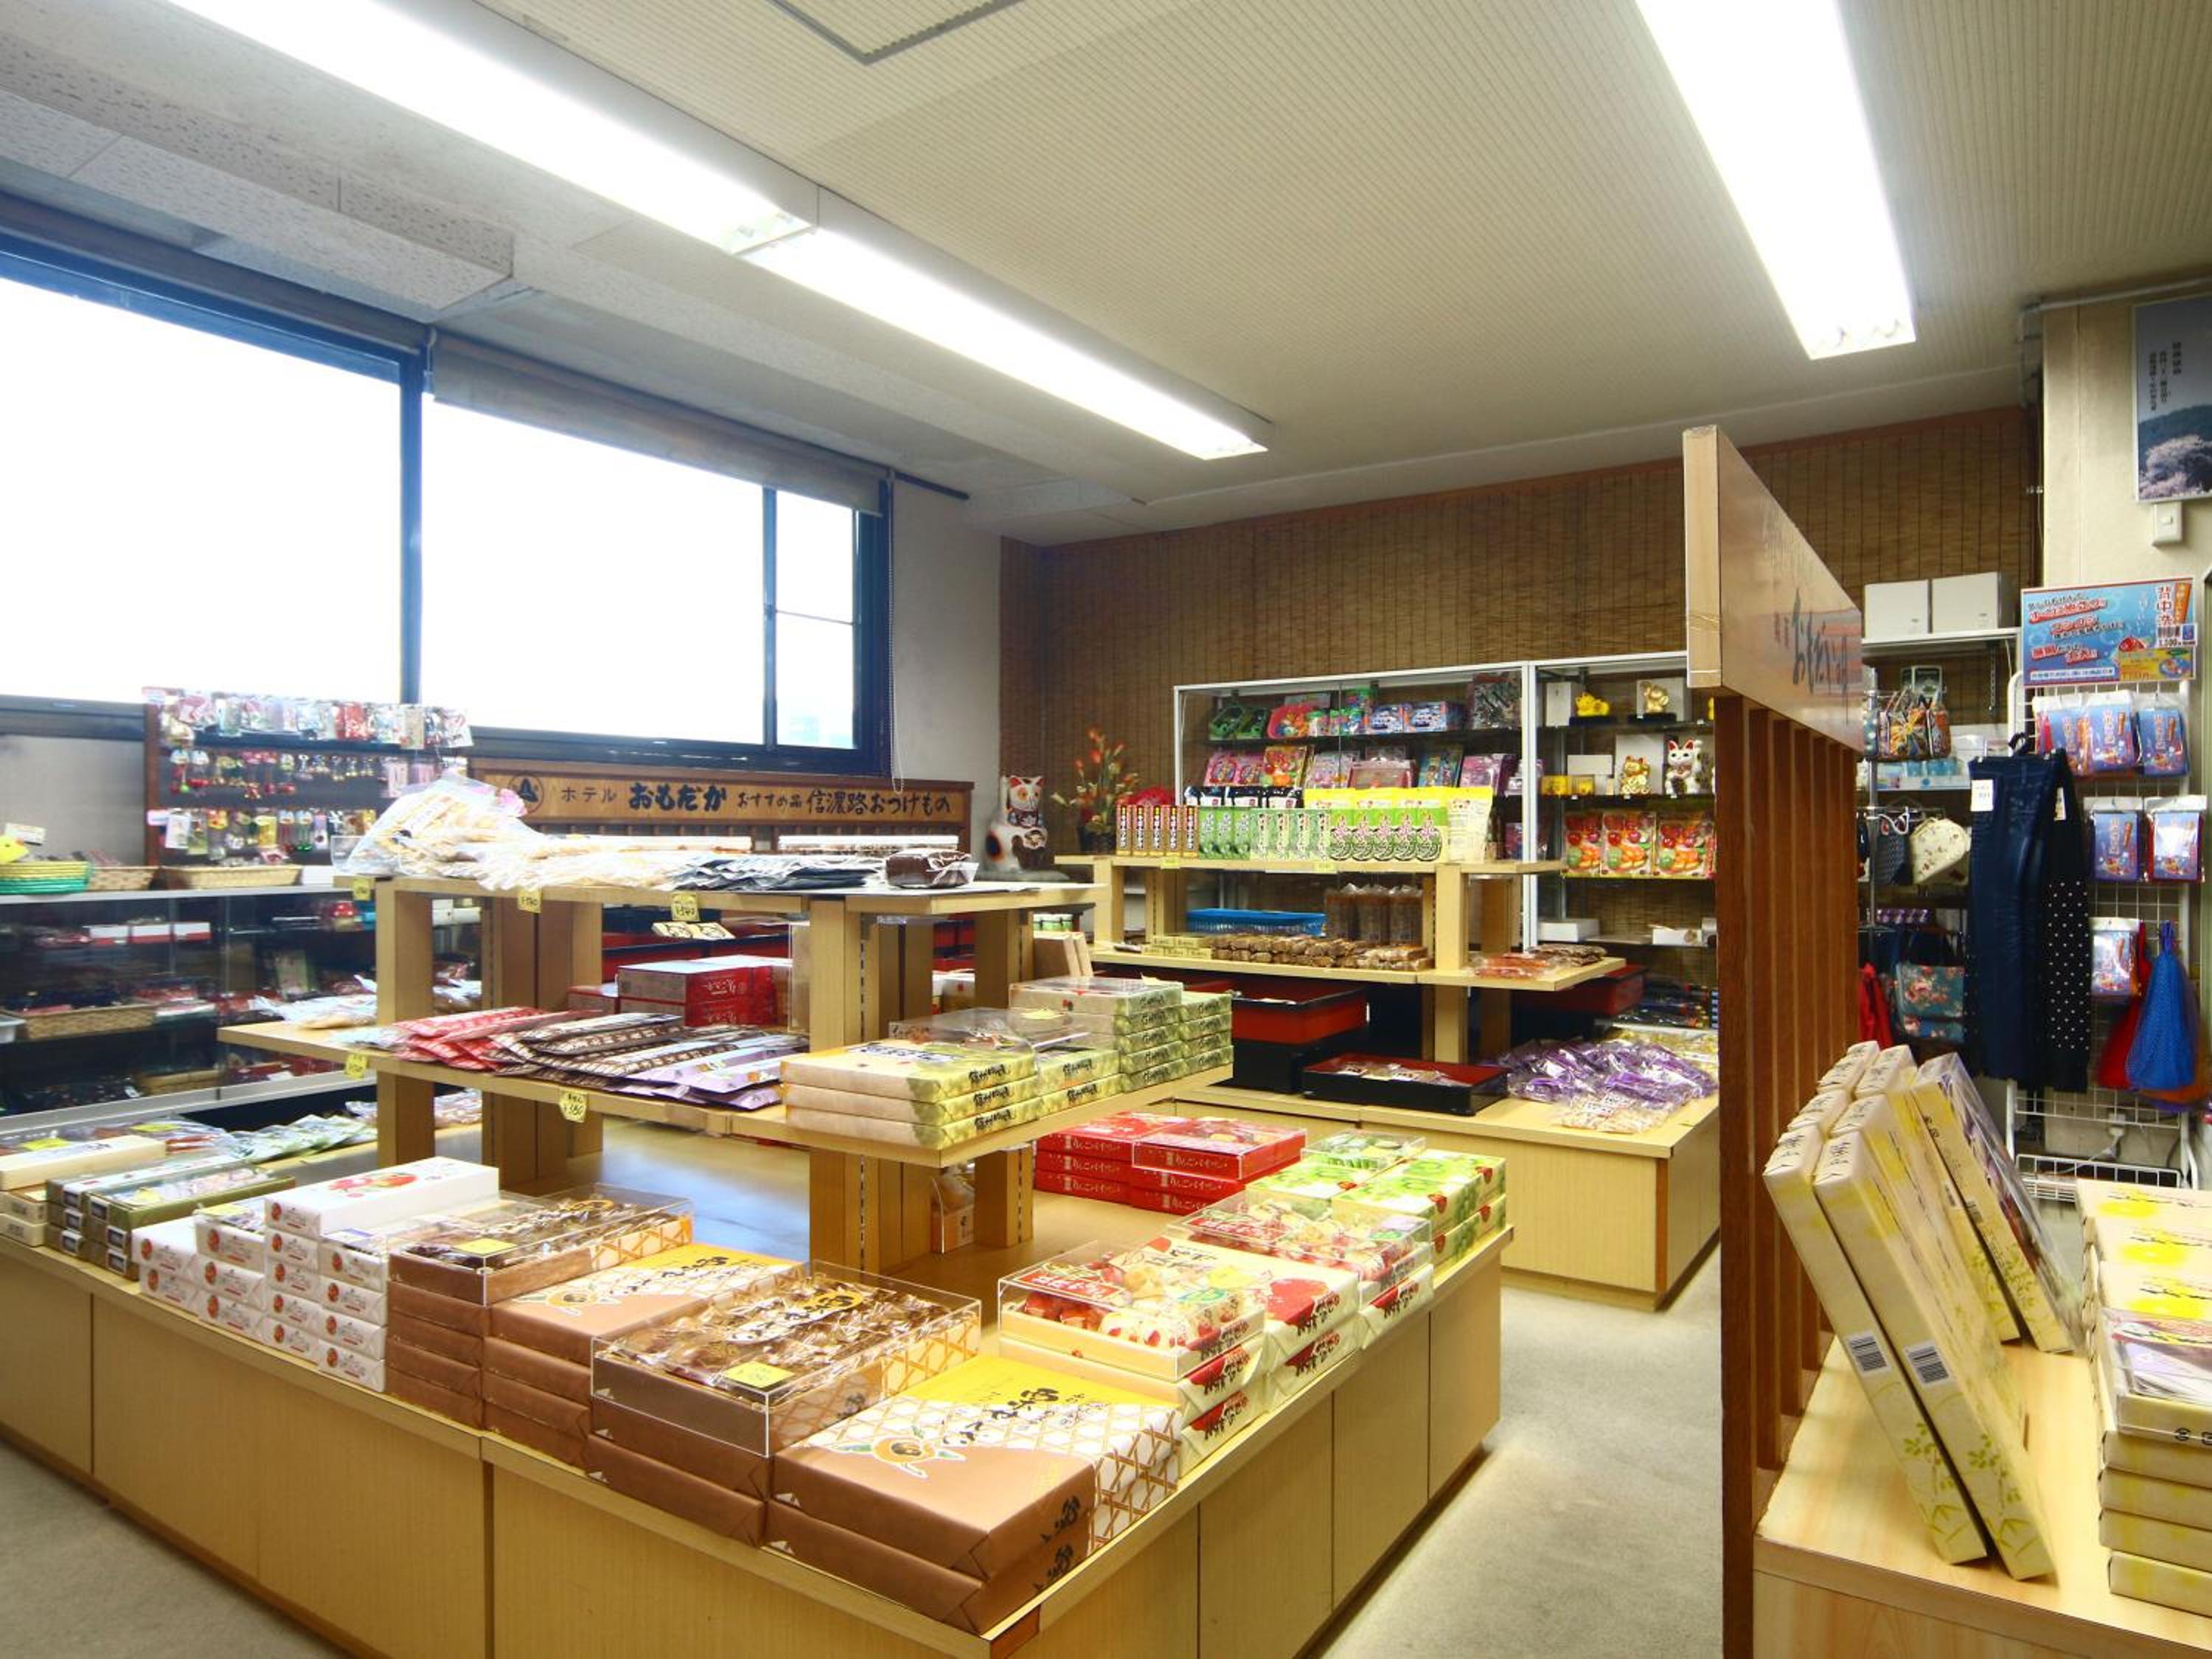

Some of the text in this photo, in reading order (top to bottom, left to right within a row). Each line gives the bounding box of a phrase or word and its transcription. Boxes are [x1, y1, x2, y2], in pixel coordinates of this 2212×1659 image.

[561, 782, 951, 816] ホテル おもだか おすすめ品 信濃路おつけもの
